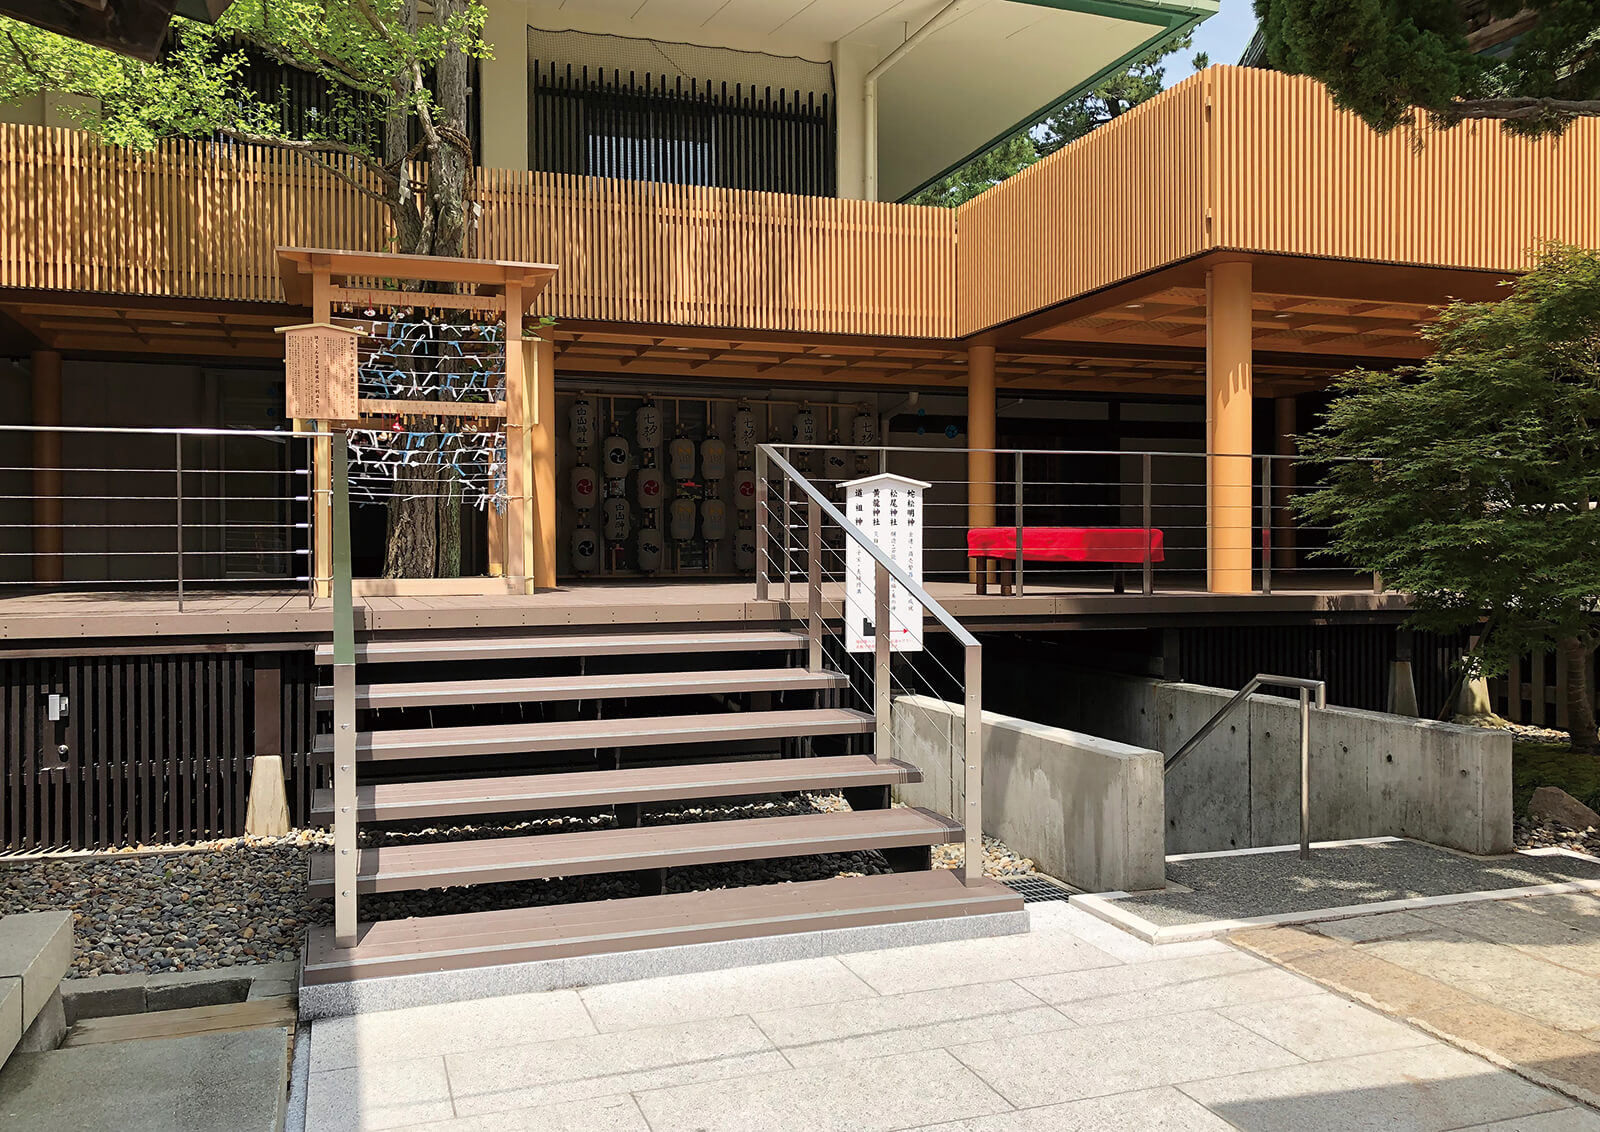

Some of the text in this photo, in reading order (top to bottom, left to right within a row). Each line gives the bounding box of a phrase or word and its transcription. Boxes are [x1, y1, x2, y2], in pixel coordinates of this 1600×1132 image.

[804, 418, 813, 444] 白山神
[855, 488, 863, 526] 道祖神
[872, 488, 881, 526] 黄龍神社
[890, 488, 898, 526] 松尾神社
[907, 489, 915, 526] 蛇松明神
